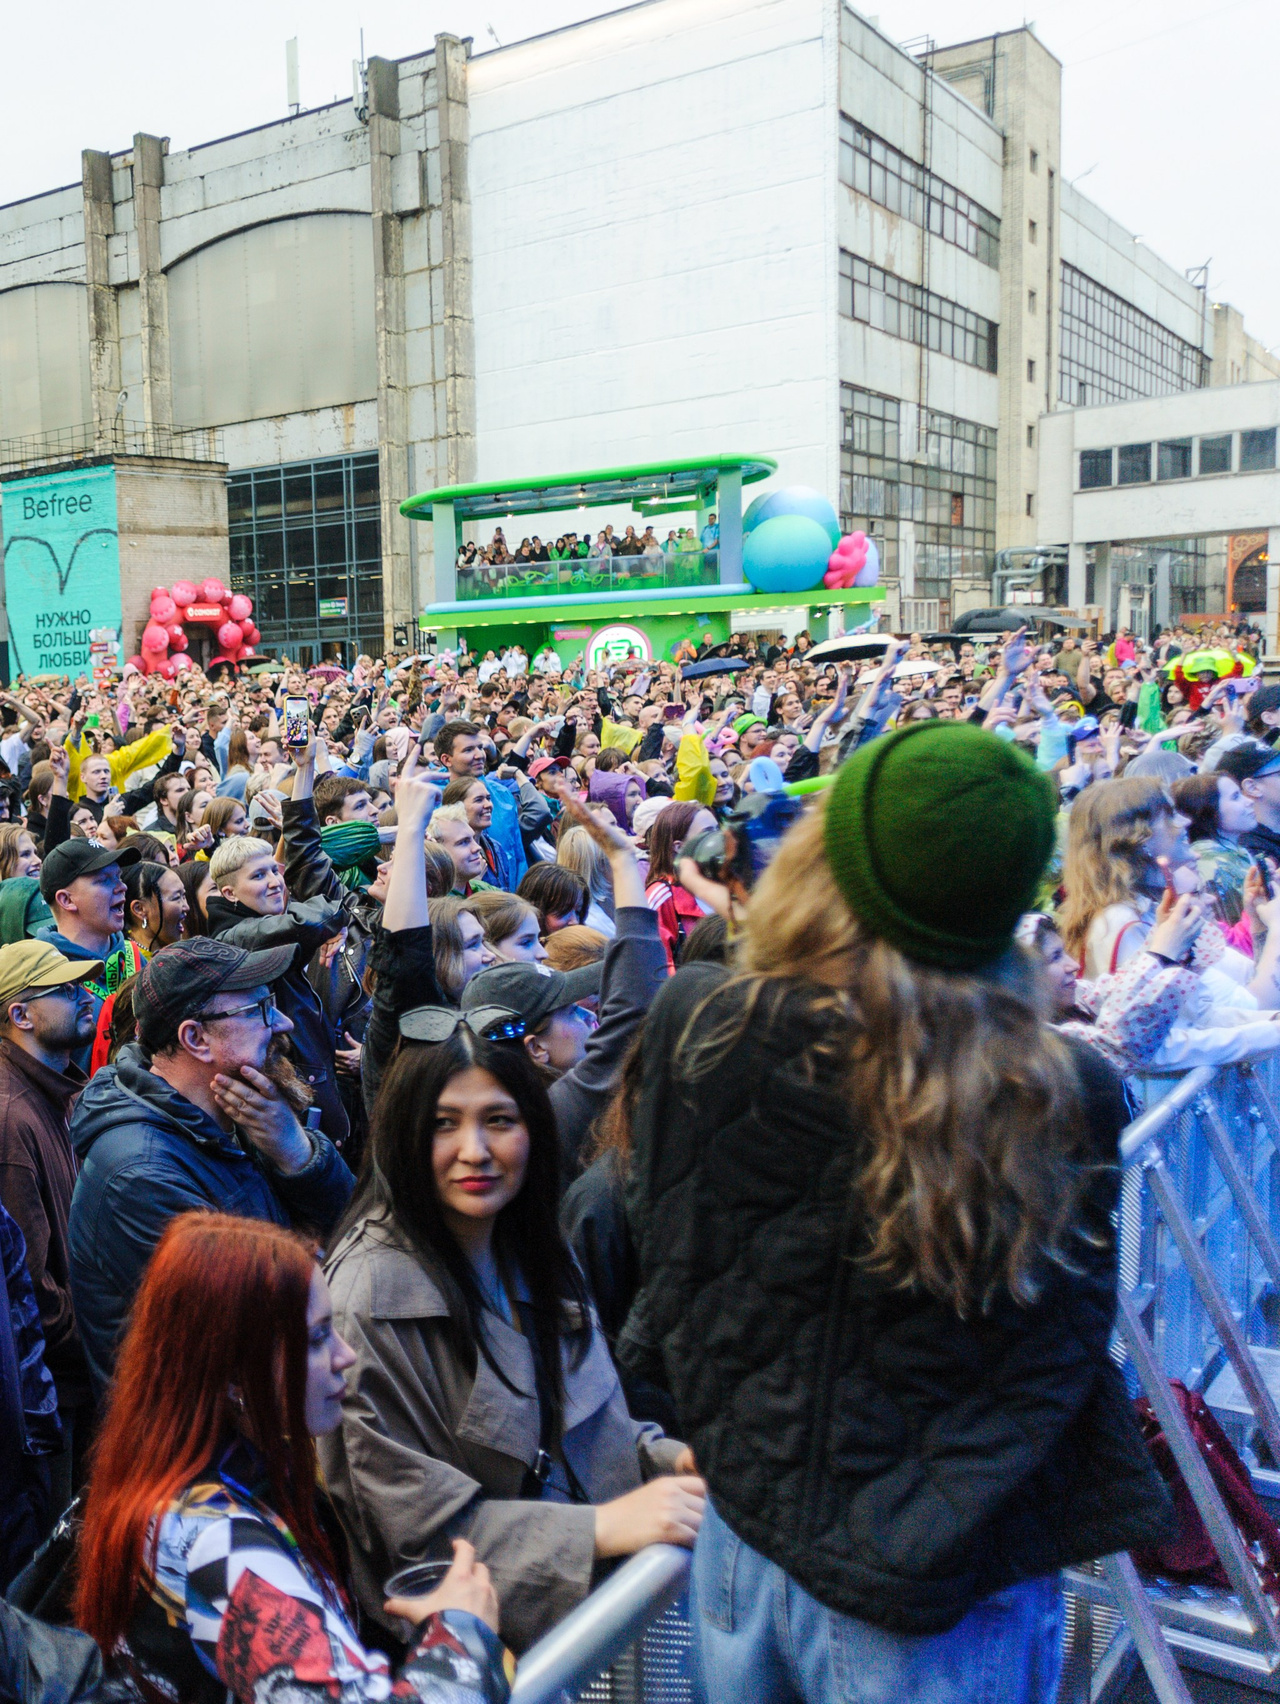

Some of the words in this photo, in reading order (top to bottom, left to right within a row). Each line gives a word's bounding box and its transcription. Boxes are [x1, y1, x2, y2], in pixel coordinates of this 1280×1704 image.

[23, 493, 92, 520] Befree
[36, 609, 91, 628] НУЖНО
[33, 629, 92, 649] БОЛЬШ
